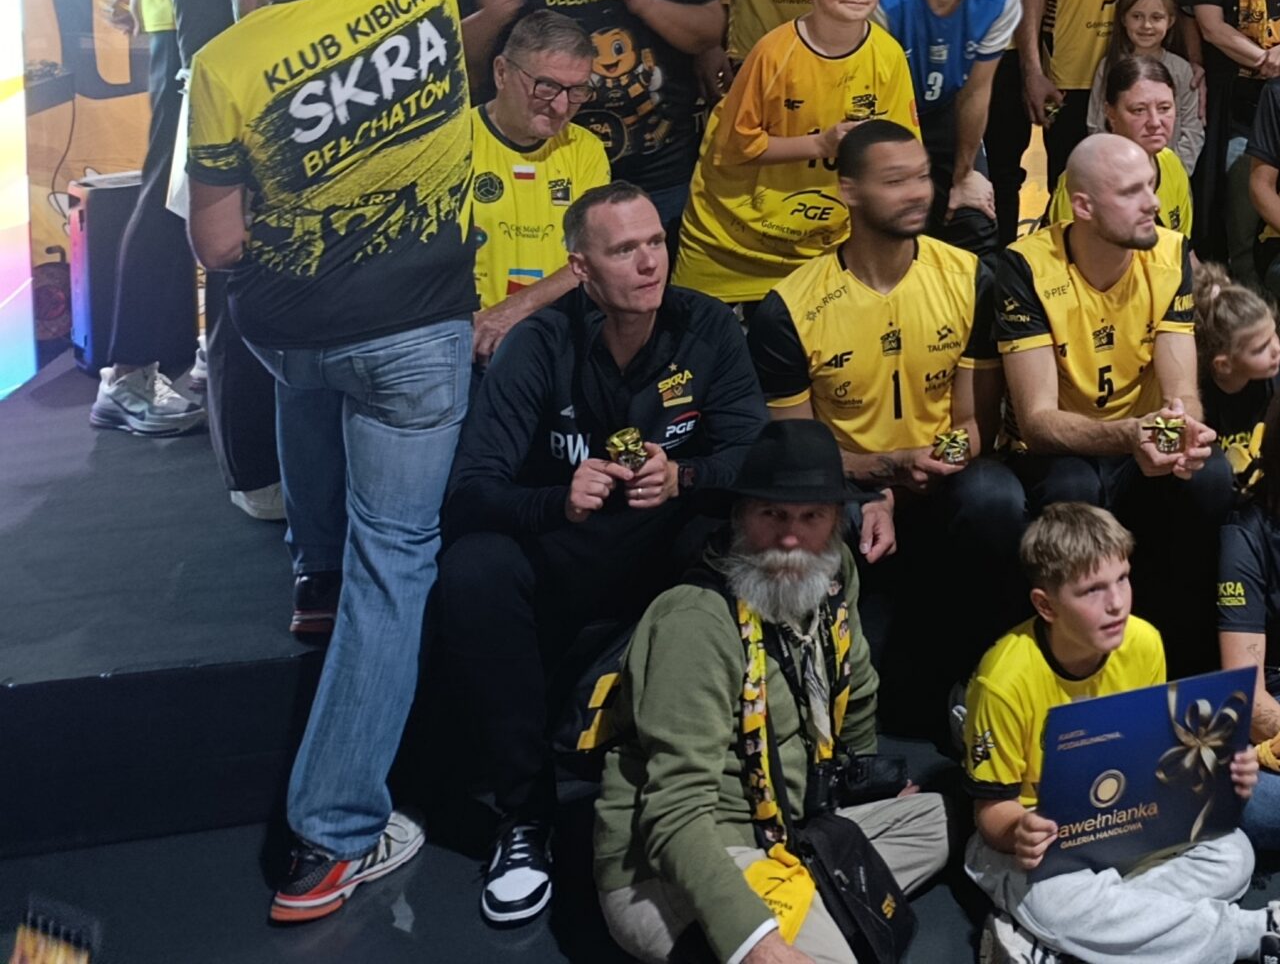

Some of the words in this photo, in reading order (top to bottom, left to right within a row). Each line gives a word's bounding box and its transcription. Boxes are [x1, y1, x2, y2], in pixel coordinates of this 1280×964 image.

[263, 33, 342, 93] KLUB
[288, 18, 448, 143] SKRA
[924, 71, 944, 101] 3
[852, 93, 877, 105] SKRA
[301, 73, 452, 179] BEŁCHATÓW
[790, 202, 834, 221] PGE
[824, 351, 853, 368] 4F
[927, 342, 962, 352] TAURON
[657, 370, 693, 393] SKRA
[892, 370, 902, 420] 1
[1096, 365, 1114, 409] 5
[665, 420, 696, 438] PGE
[1057, 801, 1159, 839] awełnianka
[1060, 834, 1096, 850] GALERIA
[1096, 821, 1143, 841] HANDLOWA
